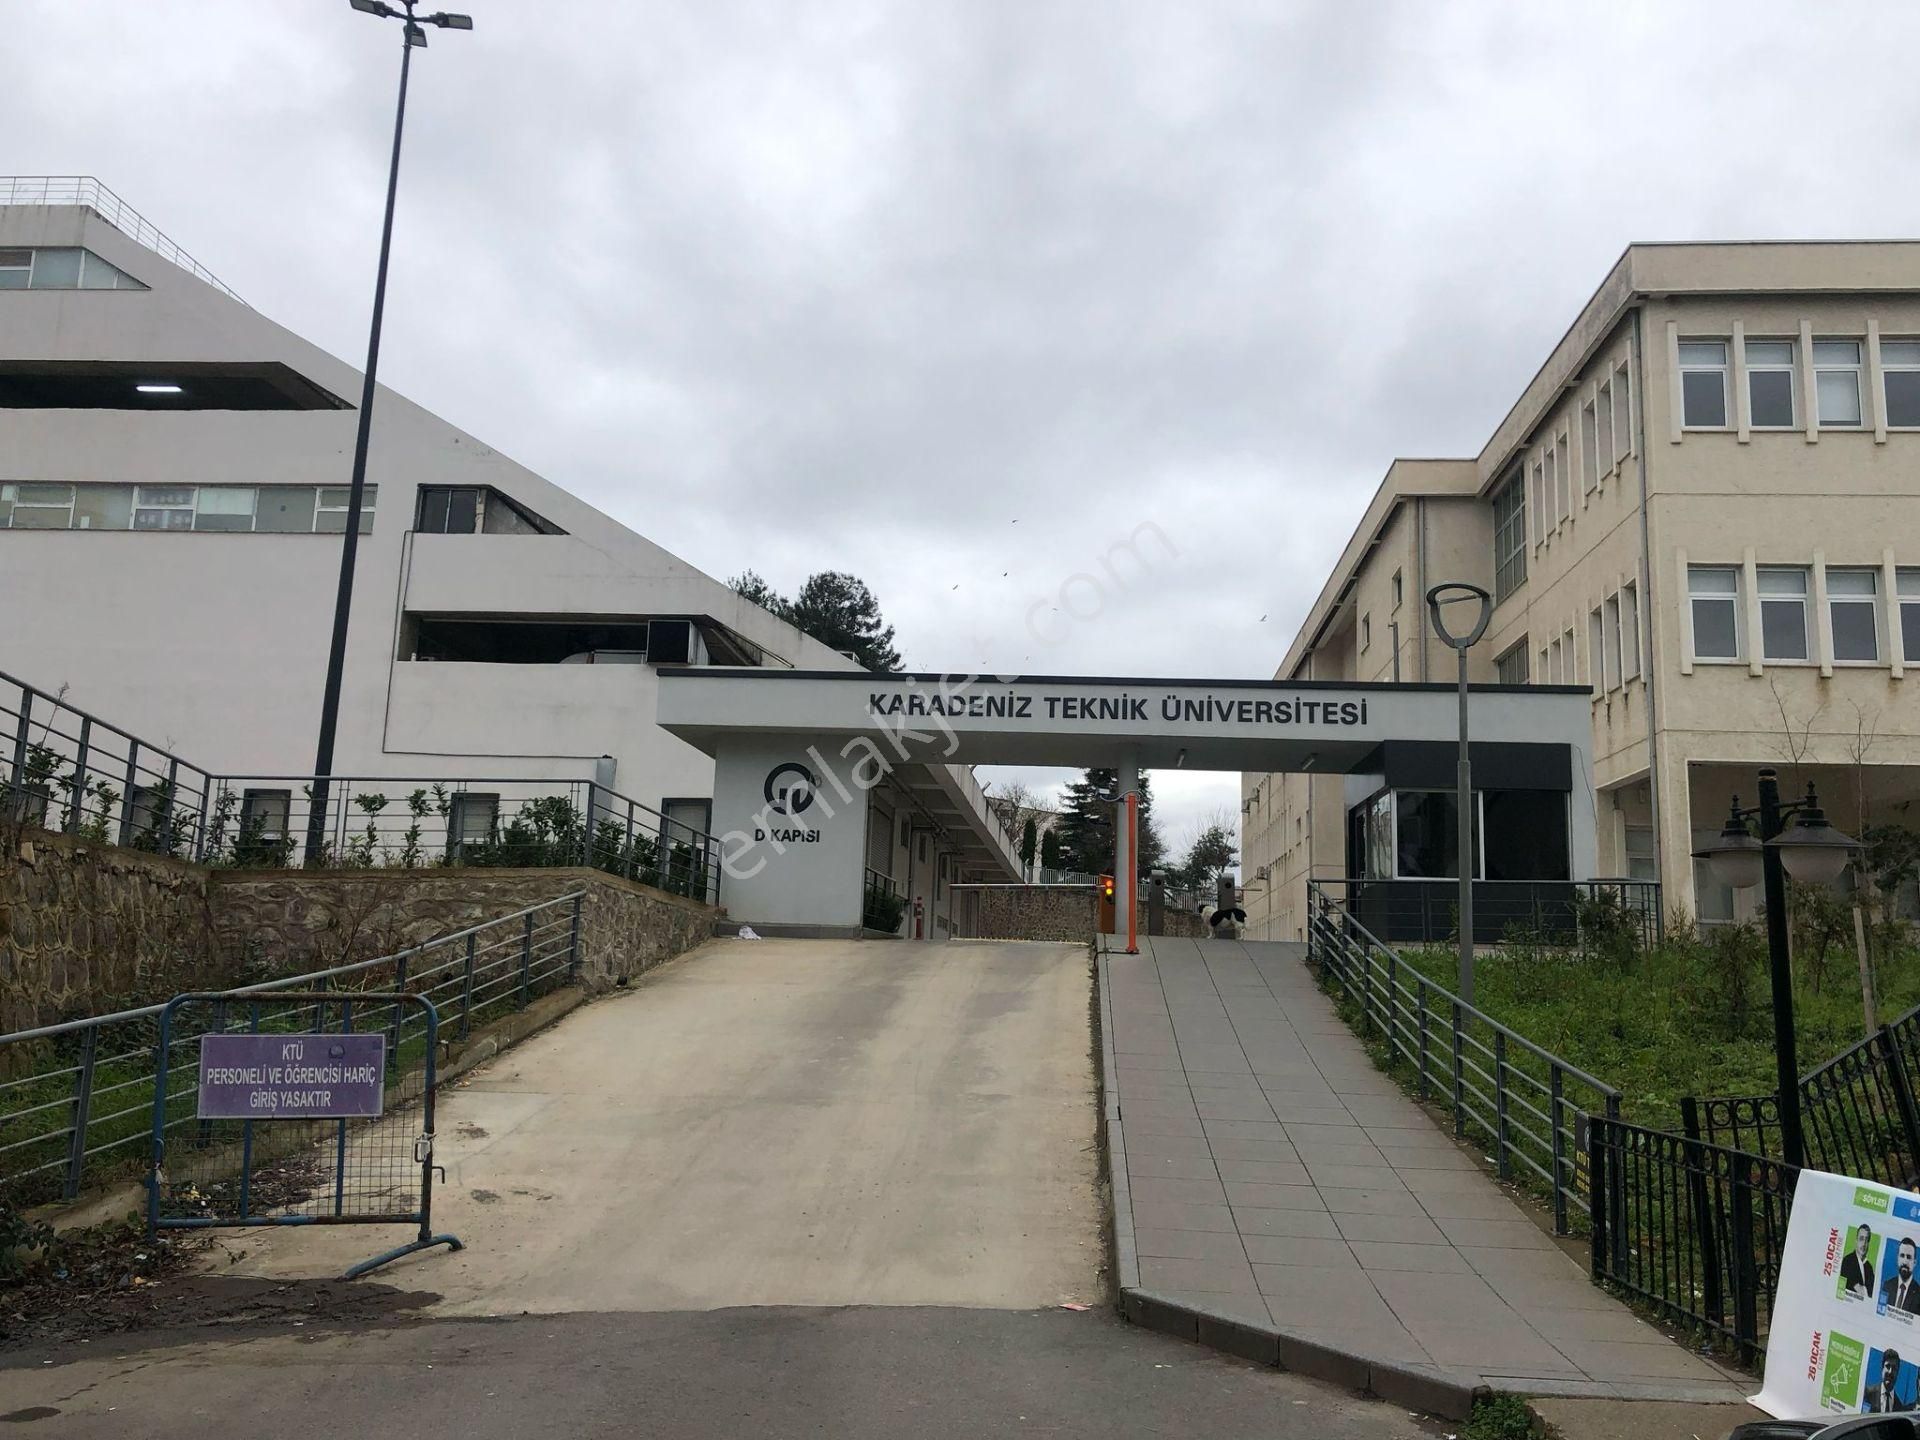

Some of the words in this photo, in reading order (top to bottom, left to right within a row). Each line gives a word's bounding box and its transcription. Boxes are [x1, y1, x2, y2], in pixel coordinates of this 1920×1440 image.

[869, 691, 1032, 718] KARADENİZ
[1044, 693, 1149, 720] TEKNİK
[1161, 695, 1368, 725] ÜNİVERSİTESİ
[754, 829, 765, 842] D
[770, 829, 820, 843] KAPISI
[282, 1040, 304, 1061] KTÜ
[207, 1064, 266, 1085] PERSONELİ
[268, 1068, 282, 1084] VE
[284, 1063, 342, 1084] ÖĞRENCİSİ
[343, 1062, 376, 1087] HARİÇ
[250, 1088, 278, 1111] GİRİŞ
[280, 1091, 331, 1108] YASAKTIR
[1826, 1228, 1839, 1261] OCAK
[1824, 1262, 1833, 1277] 25
[1811, 1331, 1823, 1365] OCAK
[1808, 1366, 1817, 1382] 26
